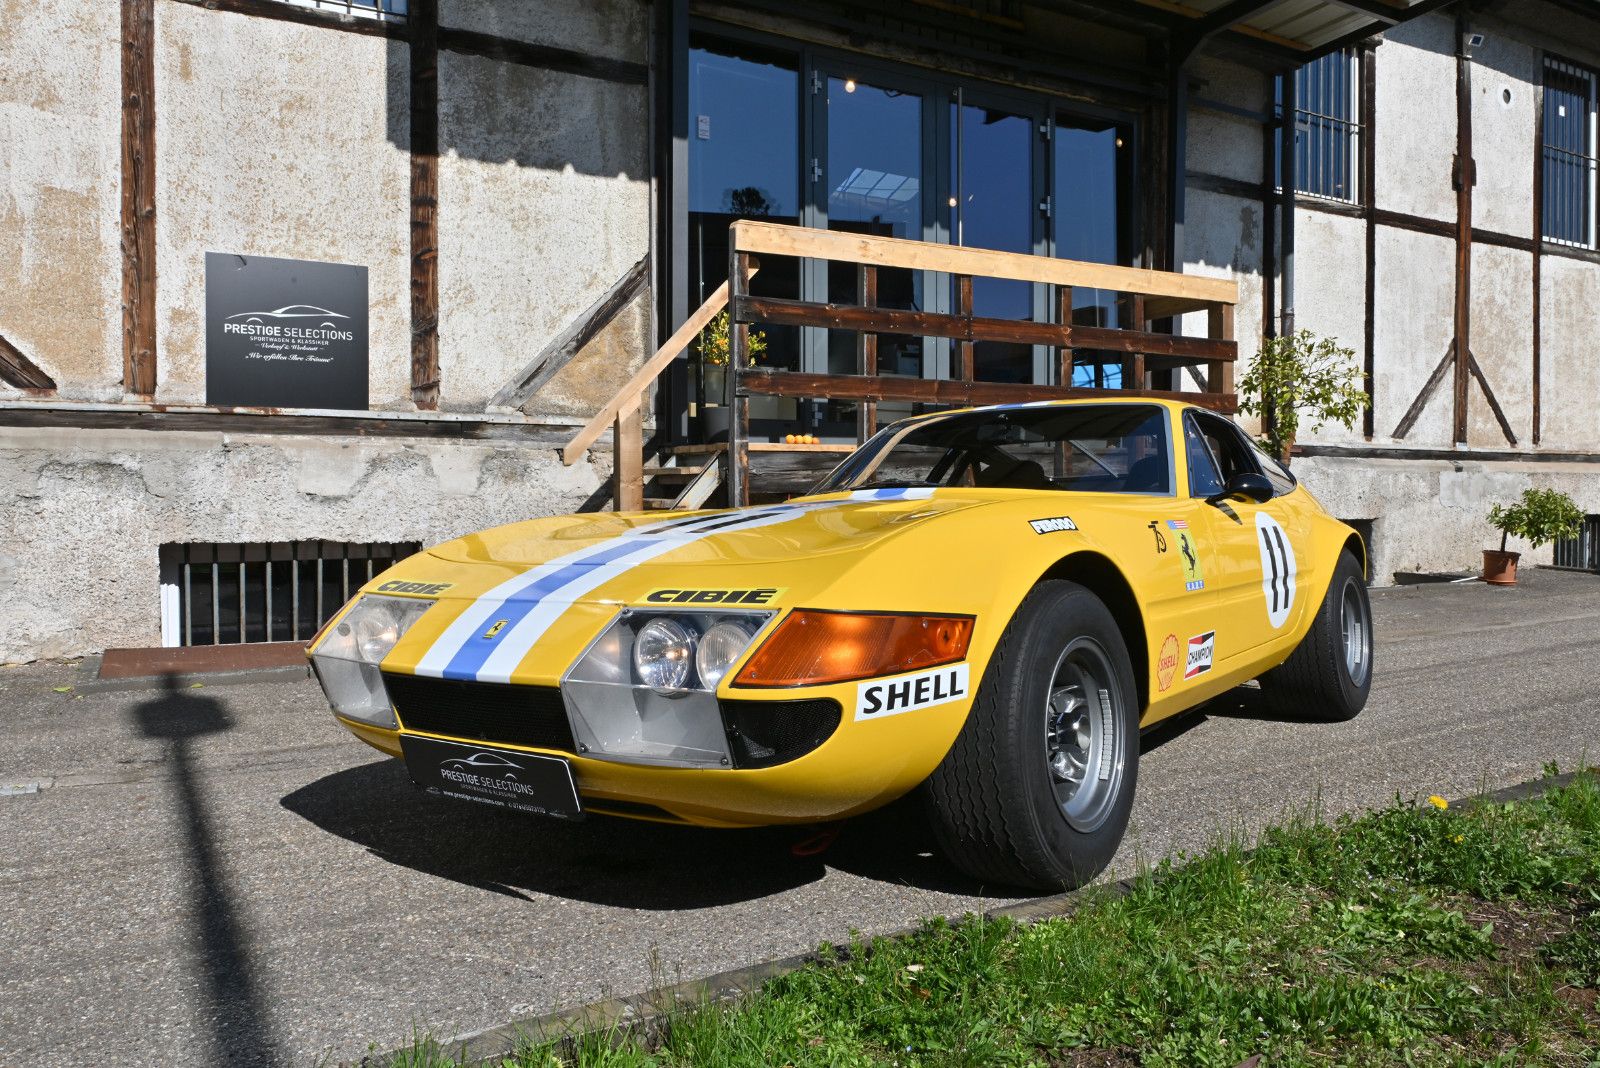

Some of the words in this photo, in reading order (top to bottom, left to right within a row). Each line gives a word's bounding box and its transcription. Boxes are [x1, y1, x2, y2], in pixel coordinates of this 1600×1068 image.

[224, 323, 281, 336] PRESTIGE
[284, 327, 353, 341] SELECTIONS
[263, 353, 287, 361] erfüllen
[1260, 525, 1290, 613] 11
[1160, 654, 1176, 672] SHELL
[1187, 645, 1213, 665] CHAMPION
[863, 671, 964, 714] SHELL
[441, 769, 480, 786] PRESTIGE
[480, 776, 534, 795] SELECTIONS
